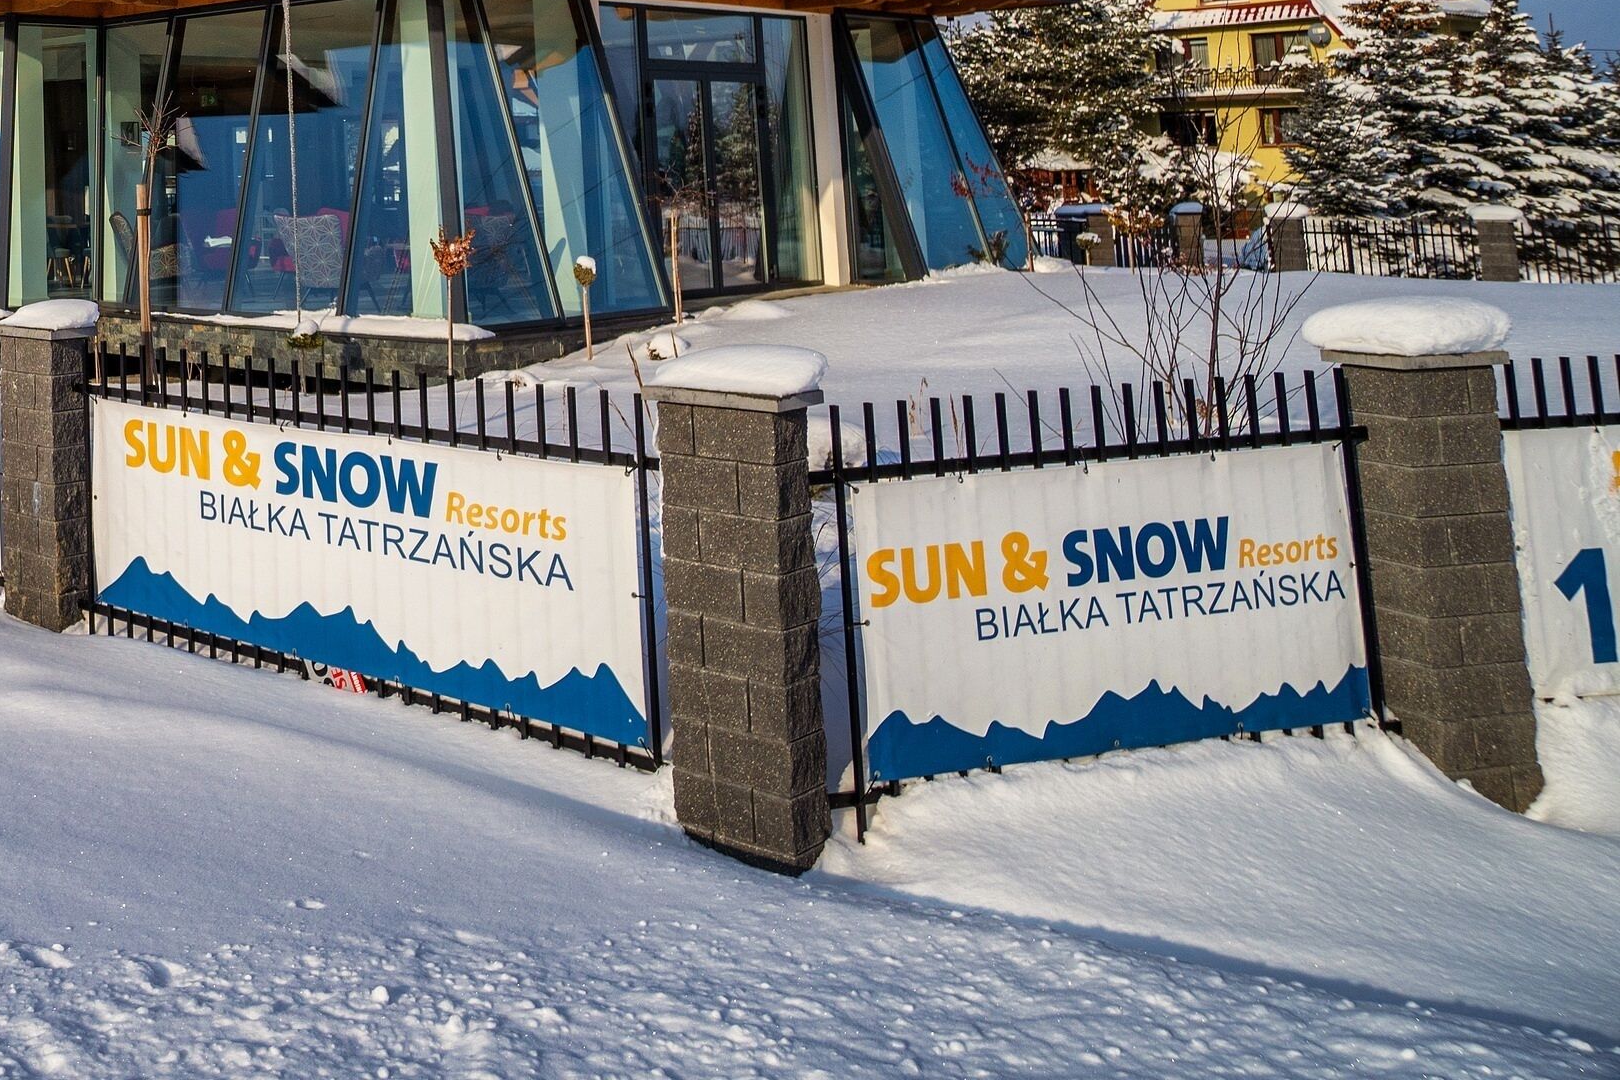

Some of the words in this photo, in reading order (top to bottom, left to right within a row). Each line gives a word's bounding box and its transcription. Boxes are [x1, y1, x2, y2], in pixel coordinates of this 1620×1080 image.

[123, 418, 211, 481] SUN
[222, 429, 261, 490] &
[273, 441, 438, 519] SNOW
[445, 491, 567, 541] Resorts
[200, 490, 311, 540] BIAŁKA
[317, 511, 574, 591] TATRZAŃSKA
[866, 540, 988, 608] SUN
[1000, 530, 1050, 594] &
[1062, 515, 1229, 588] SNOW
[1238, 532, 1338, 569] Resorts
[975, 595, 1110, 642] BIAŁKA
[1115, 570, 1347, 624] TATRZAŃSKA
